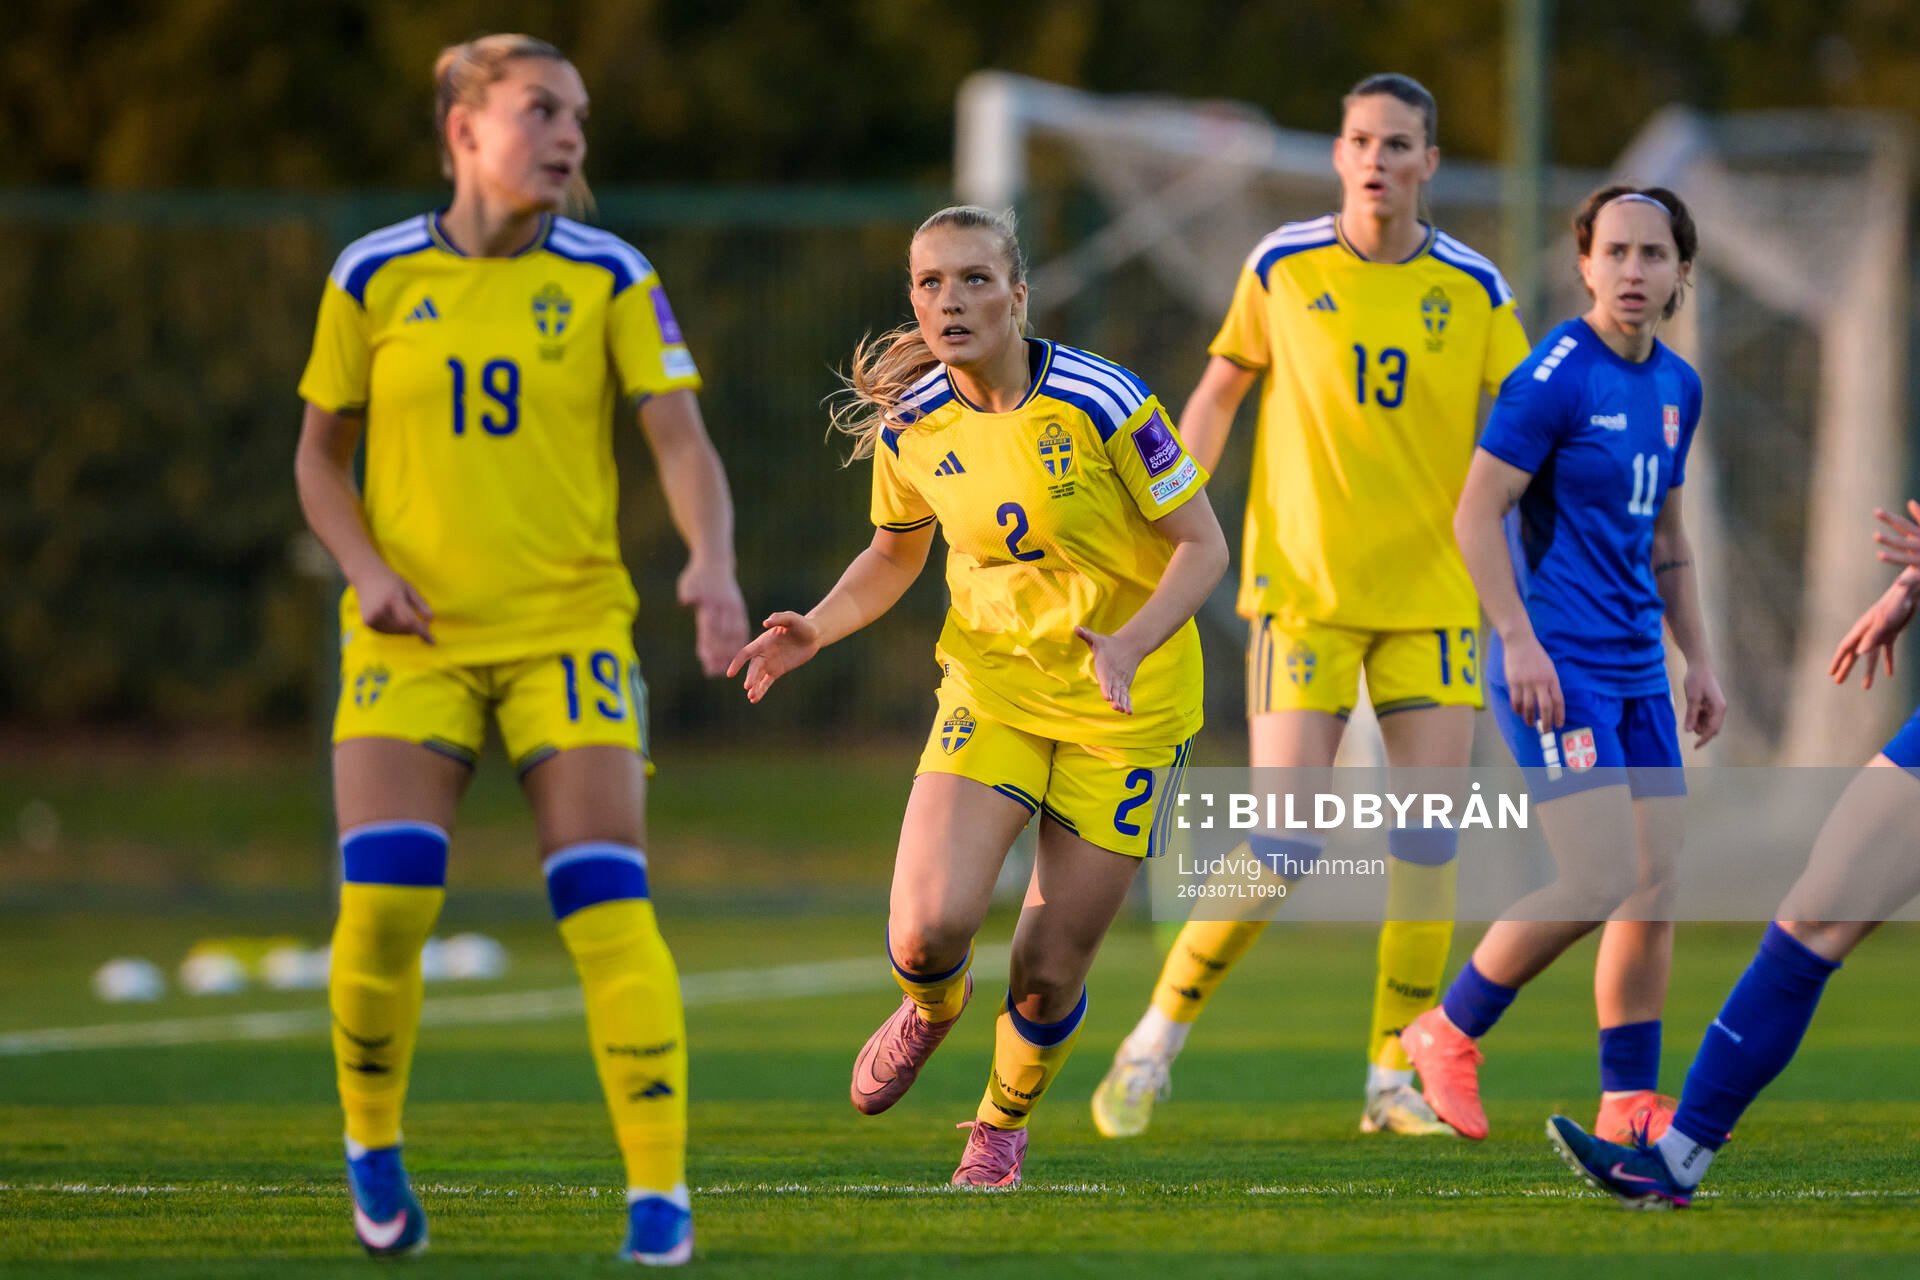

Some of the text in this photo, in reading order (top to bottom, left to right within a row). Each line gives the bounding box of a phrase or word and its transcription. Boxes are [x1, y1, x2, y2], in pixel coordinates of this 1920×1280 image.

[447, 357, 520, 436] 19
[1353, 344, 1408, 408] 13
[1628, 452, 1659, 516] 11
[996, 502, 1045, 562] 2
[562, 650, 626, 721] 19
[1435, 628, 1477, 686] 13
[1114, 768, 1157, 836] 2
